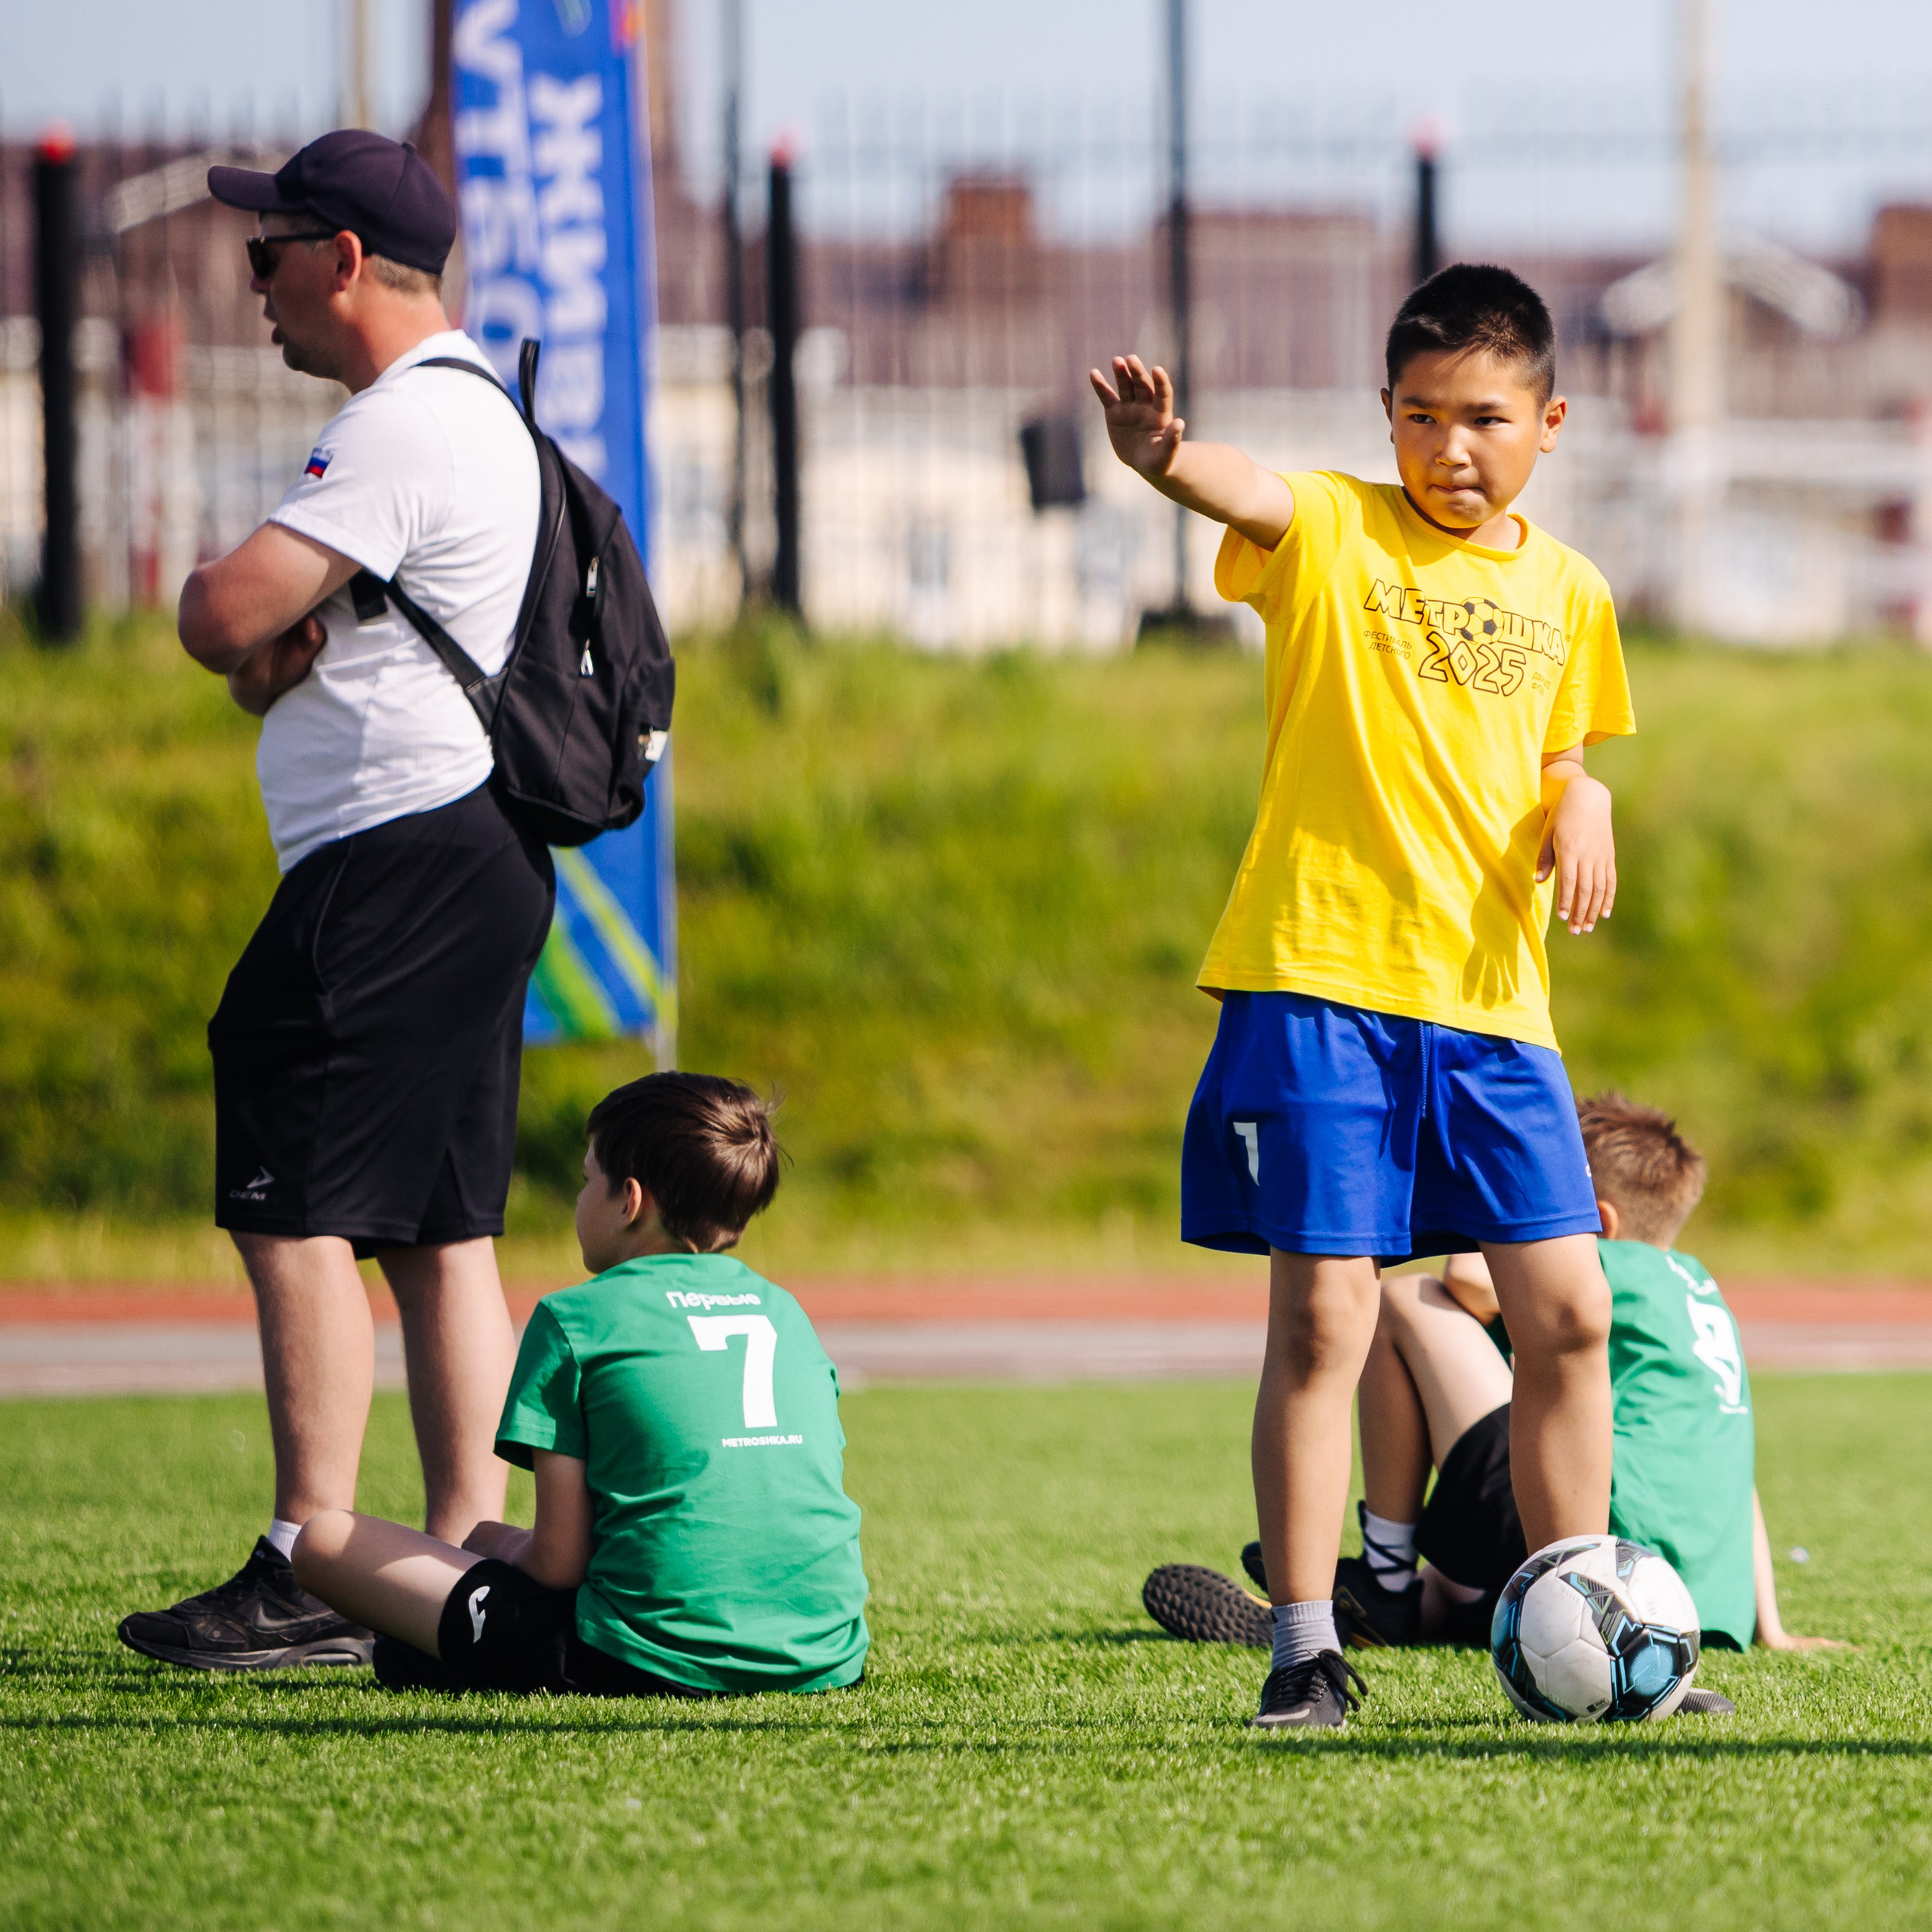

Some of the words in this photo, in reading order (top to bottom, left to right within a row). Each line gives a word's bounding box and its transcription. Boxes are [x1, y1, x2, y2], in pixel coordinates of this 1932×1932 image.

[1363, 629, 1413, 650] ФЕСТИВАЛЬ
[1367, 641, 1411, 660] ДЕТСКОГО
[1417, 630, 1527, 697] 2025
[666, 1291, 761, 1311] Первые
[686, 1313, 778, 1429] 7
[721, 1434, 803, 1447] METROSHKA.RU
